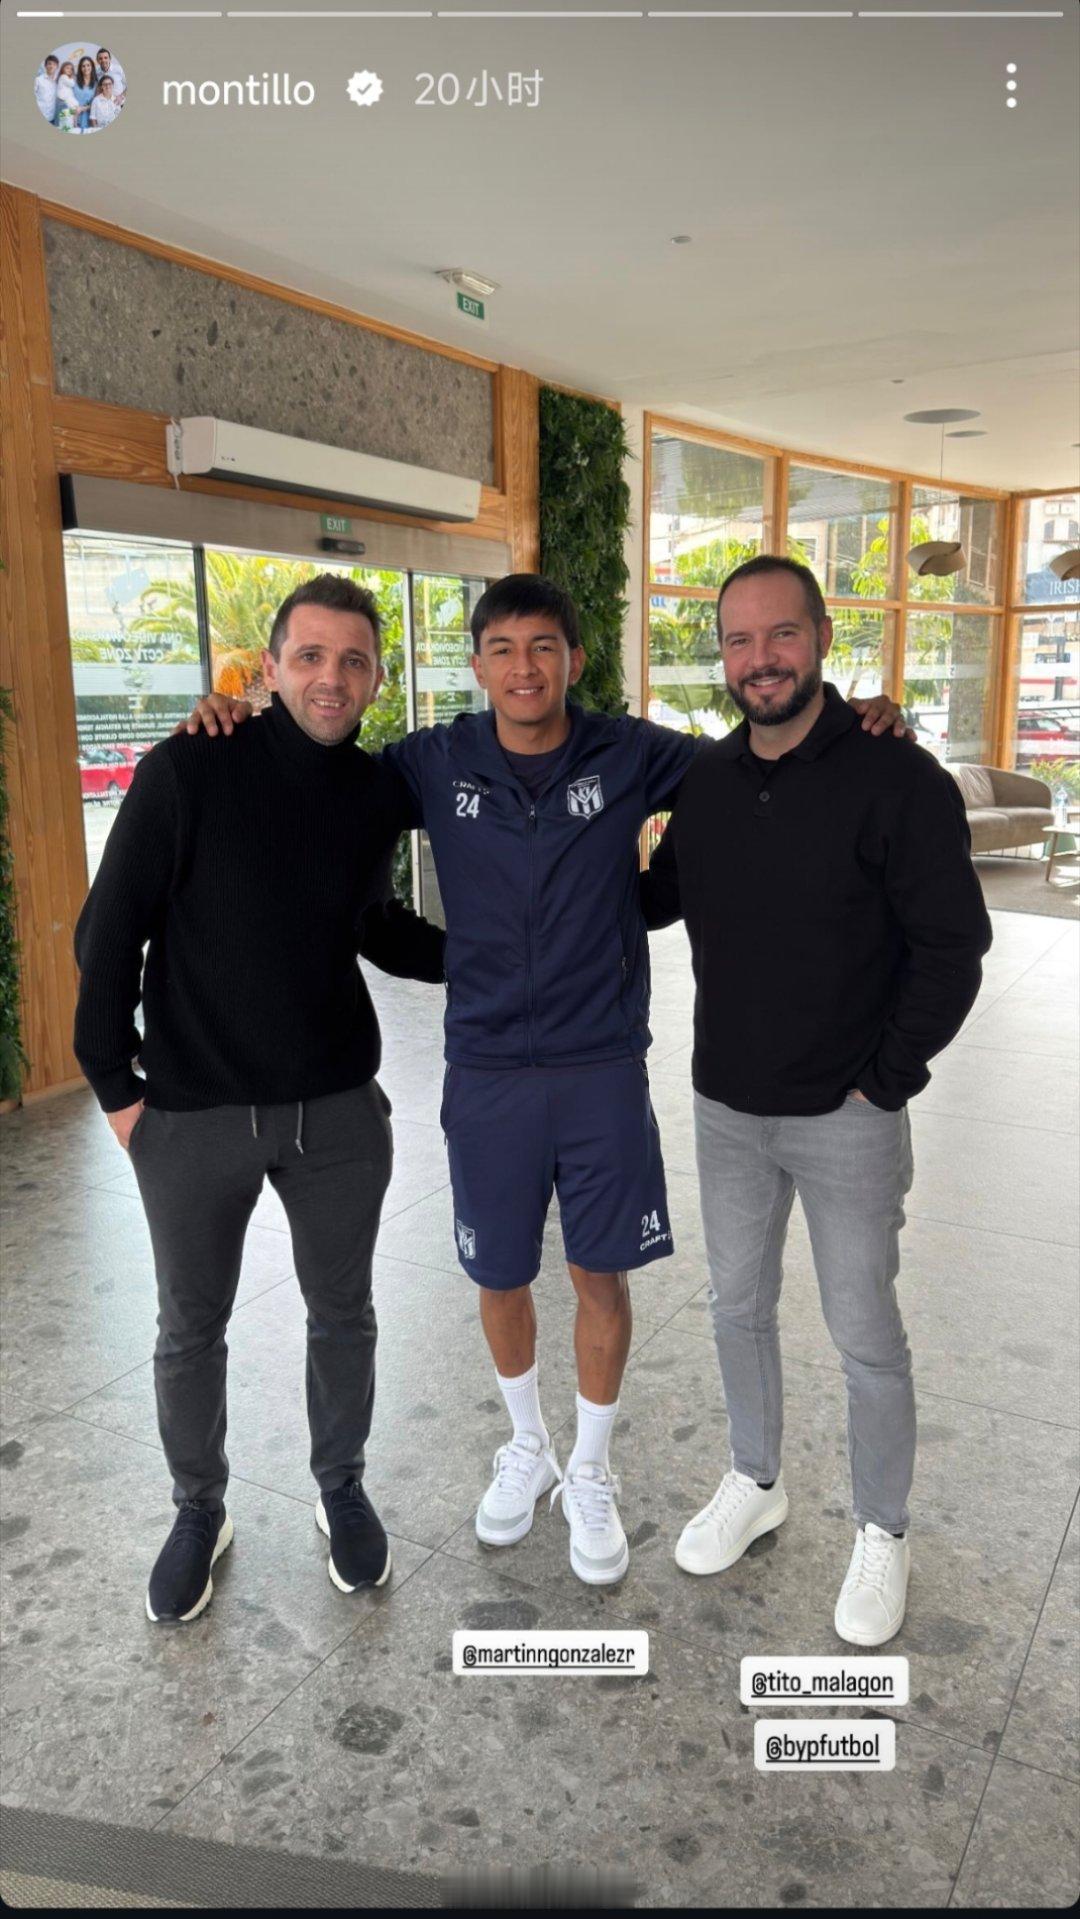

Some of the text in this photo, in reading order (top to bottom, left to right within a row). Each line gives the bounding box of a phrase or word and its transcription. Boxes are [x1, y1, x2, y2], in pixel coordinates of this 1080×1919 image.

[462, 300, 480, 317] EXIT
[326, 518, 347, 532] EXIT
[456, 793, 480, 818] 24
[641, 1209, 661, 1237] 24
[640, 1233, 668, 1251] CRAFT
